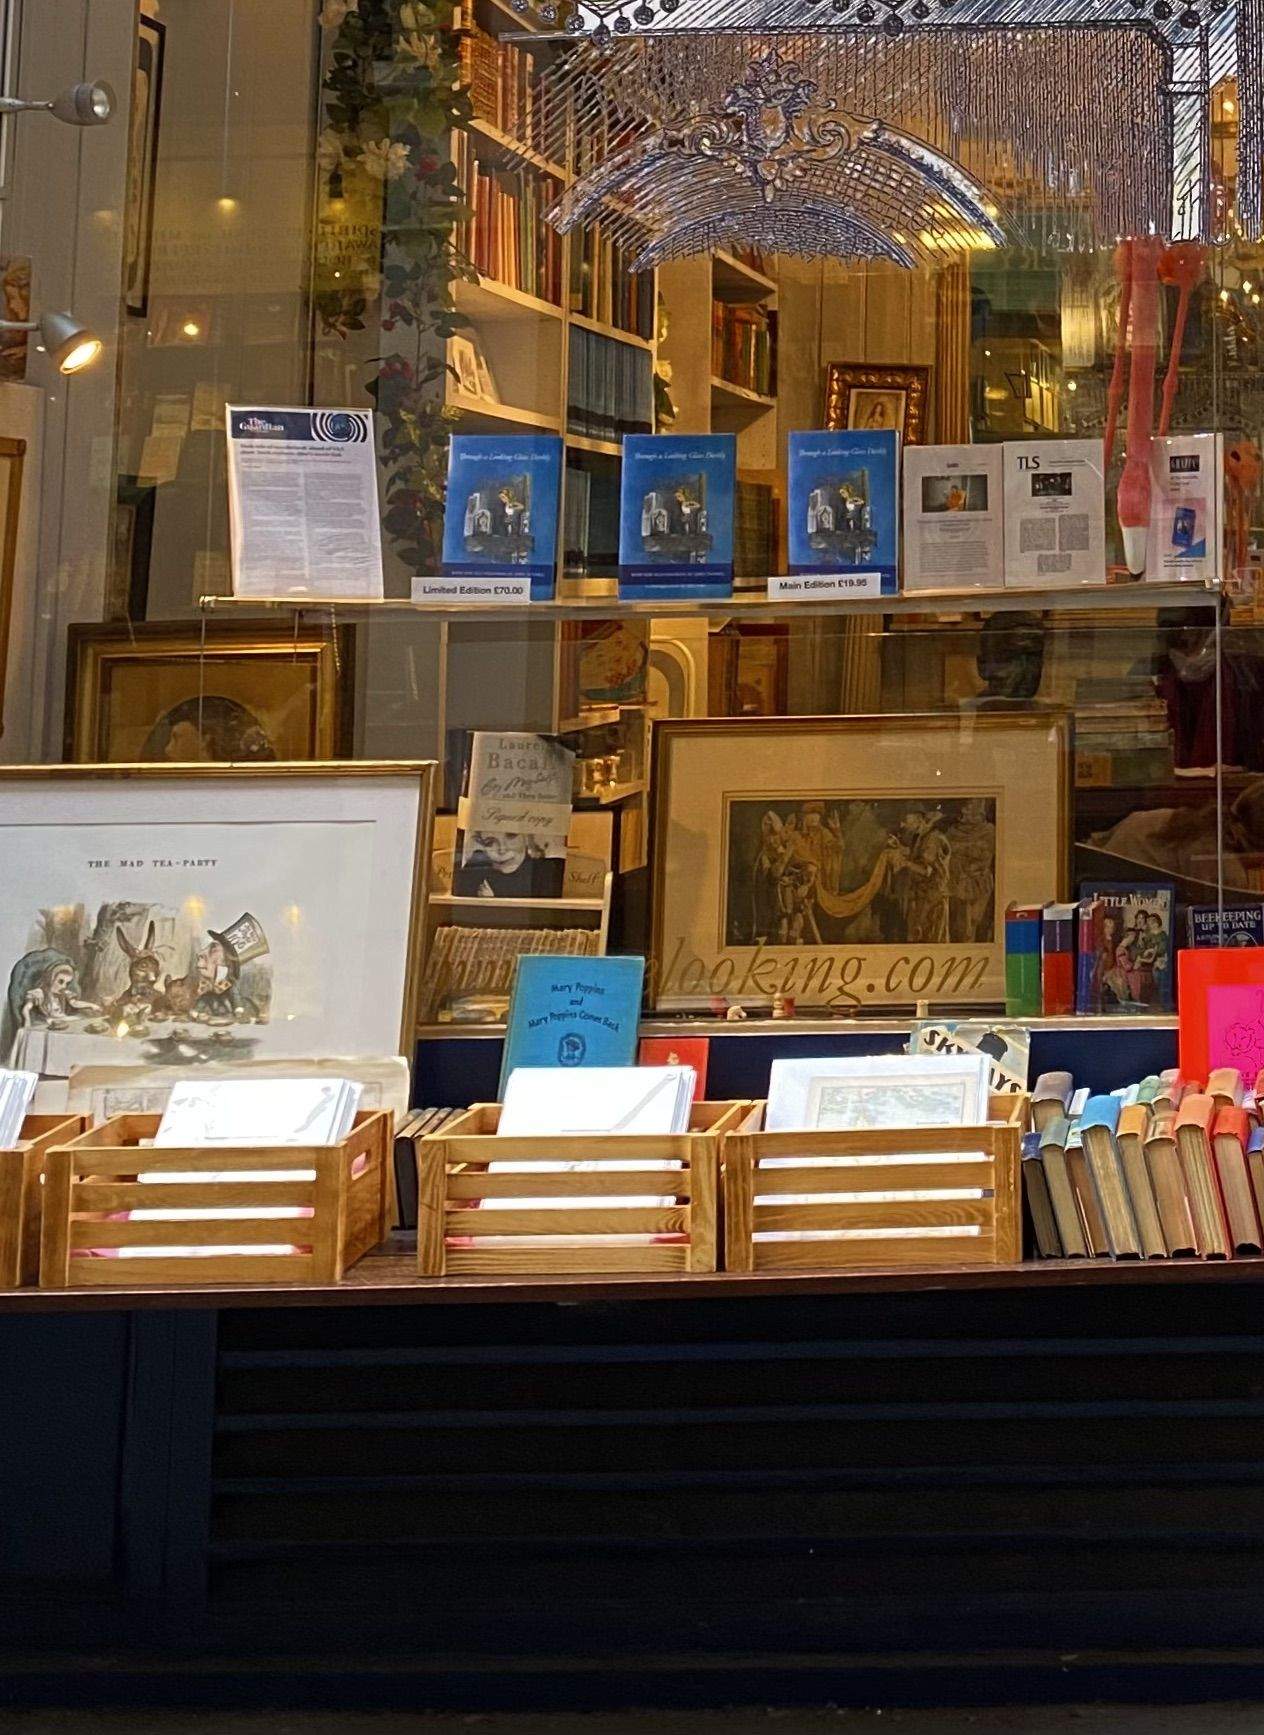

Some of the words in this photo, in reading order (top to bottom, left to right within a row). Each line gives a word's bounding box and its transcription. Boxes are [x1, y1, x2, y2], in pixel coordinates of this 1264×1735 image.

[239, 423, 284, 431] Guardian
[1017, 456, 1040, 470] TLS
[423, 585, 458, 595] Limited
[459, 585, 492, 595] Edition
[494, 586, 524, 595] £70.00
[779, 581, 802, 590] Main
[804, 580, 836, 589] Edition
[87, 860, 110, 868] THE
[120, 860, 144, 868] MAD
[152, 860, 218, 868] TEA-PARTY
[1194, 910, 1261, 924] BEEKEEPING
[1201, 923, 1215, 931] UP
[1231, 920, 1257, 929] DATE
[551, 983, 572, 993] Mary
[575, 982, 605, 995] Poppins
[569, 996, 584, 1006] and
[528, 1015, 549, 1028] Mary
[549, 1010, 577, 1022] Poppins
[580, 1010, 602, 1022] Comes
[602, 1016, 621, 1033] Back
